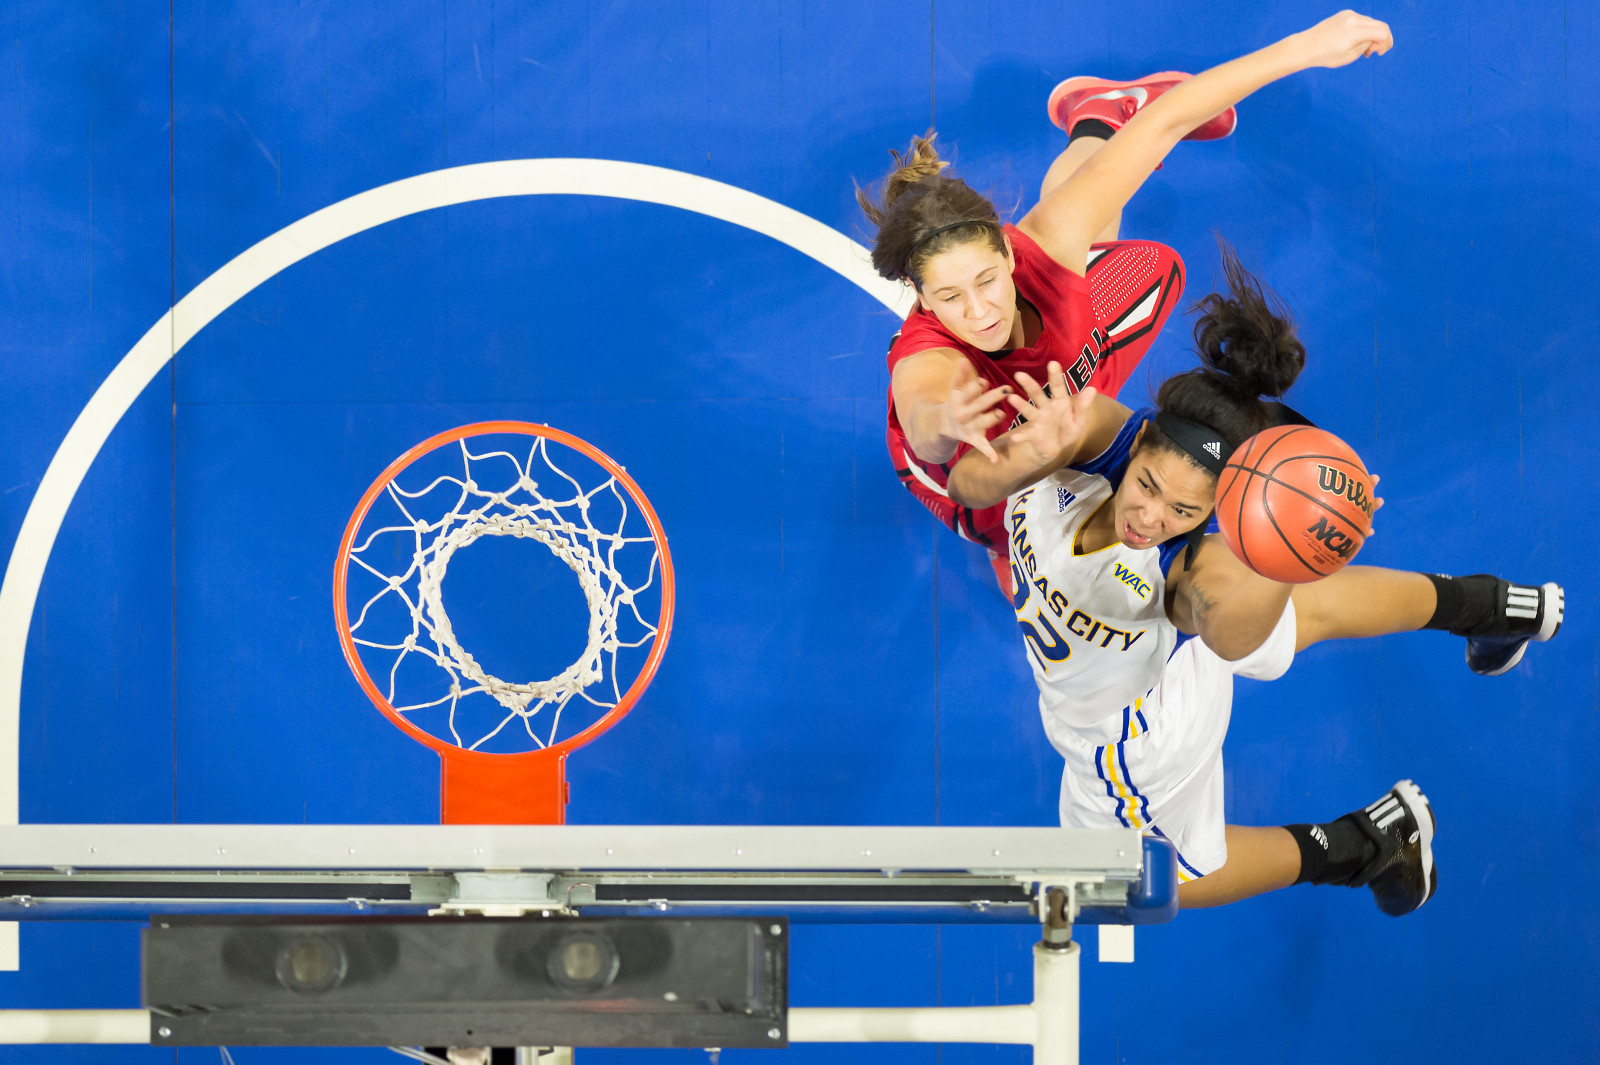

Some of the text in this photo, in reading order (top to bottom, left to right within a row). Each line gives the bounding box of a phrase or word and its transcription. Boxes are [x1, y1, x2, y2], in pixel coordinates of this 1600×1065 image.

[1202, 443, 1221, 460] adidas
[1057, 486, 1065, 513] adidas
[1011, 487, 1147, 652] KANSAS CITY
[1112, 562, 1152, 601] WAC
